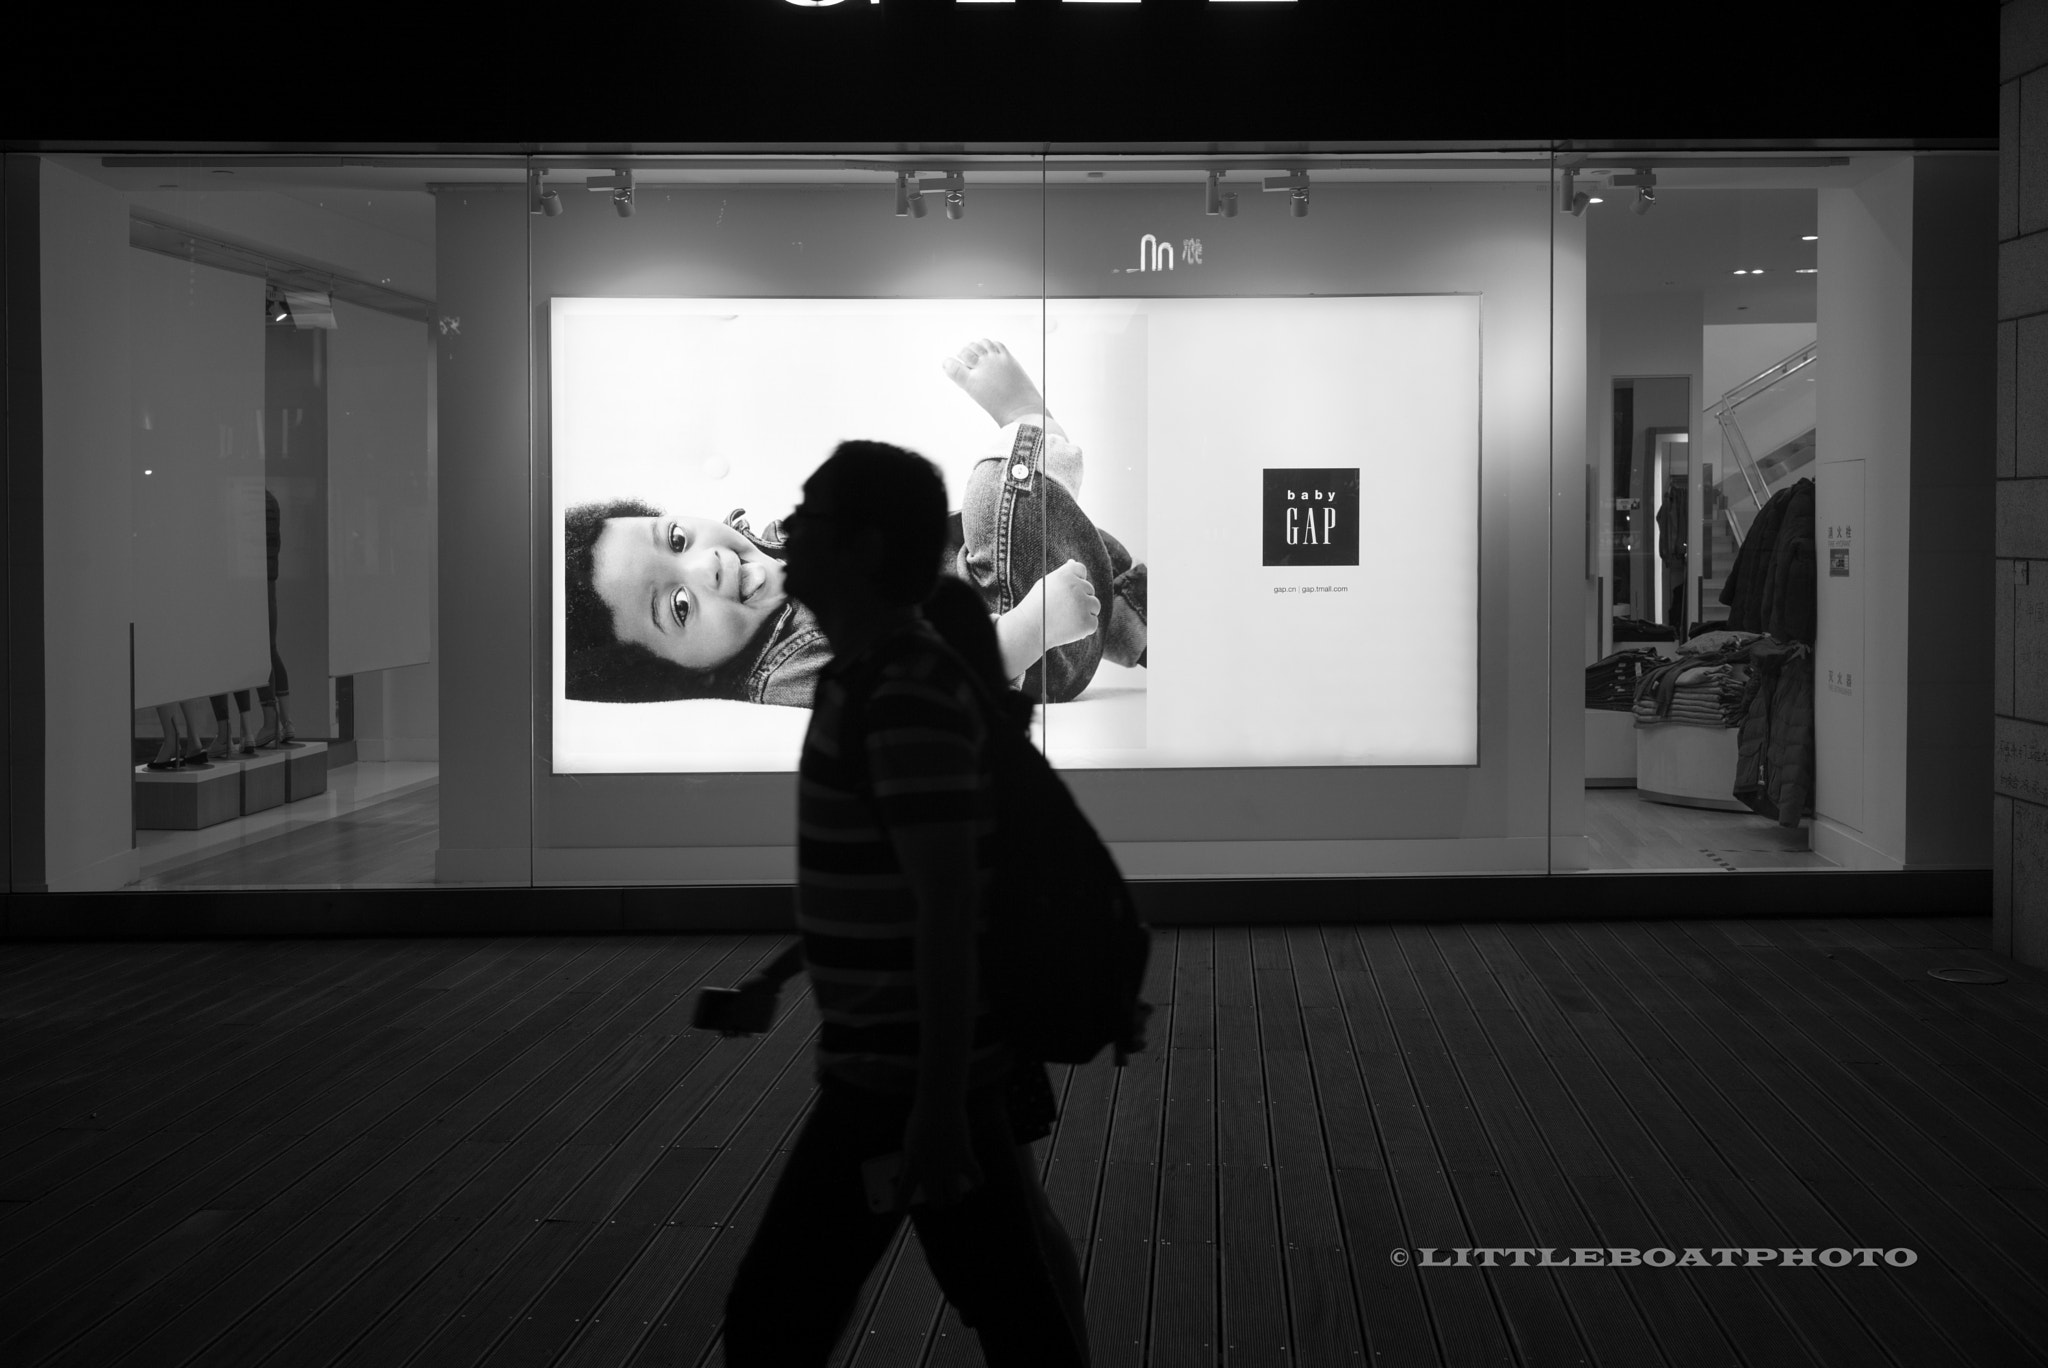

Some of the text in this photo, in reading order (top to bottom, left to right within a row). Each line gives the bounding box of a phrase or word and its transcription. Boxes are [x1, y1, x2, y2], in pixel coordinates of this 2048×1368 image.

[1287, 490, 1336, 502] baby
[1286, 507, 1336, 545] GAP
[1301, 585, 1349, 594] gap.tmall.com
